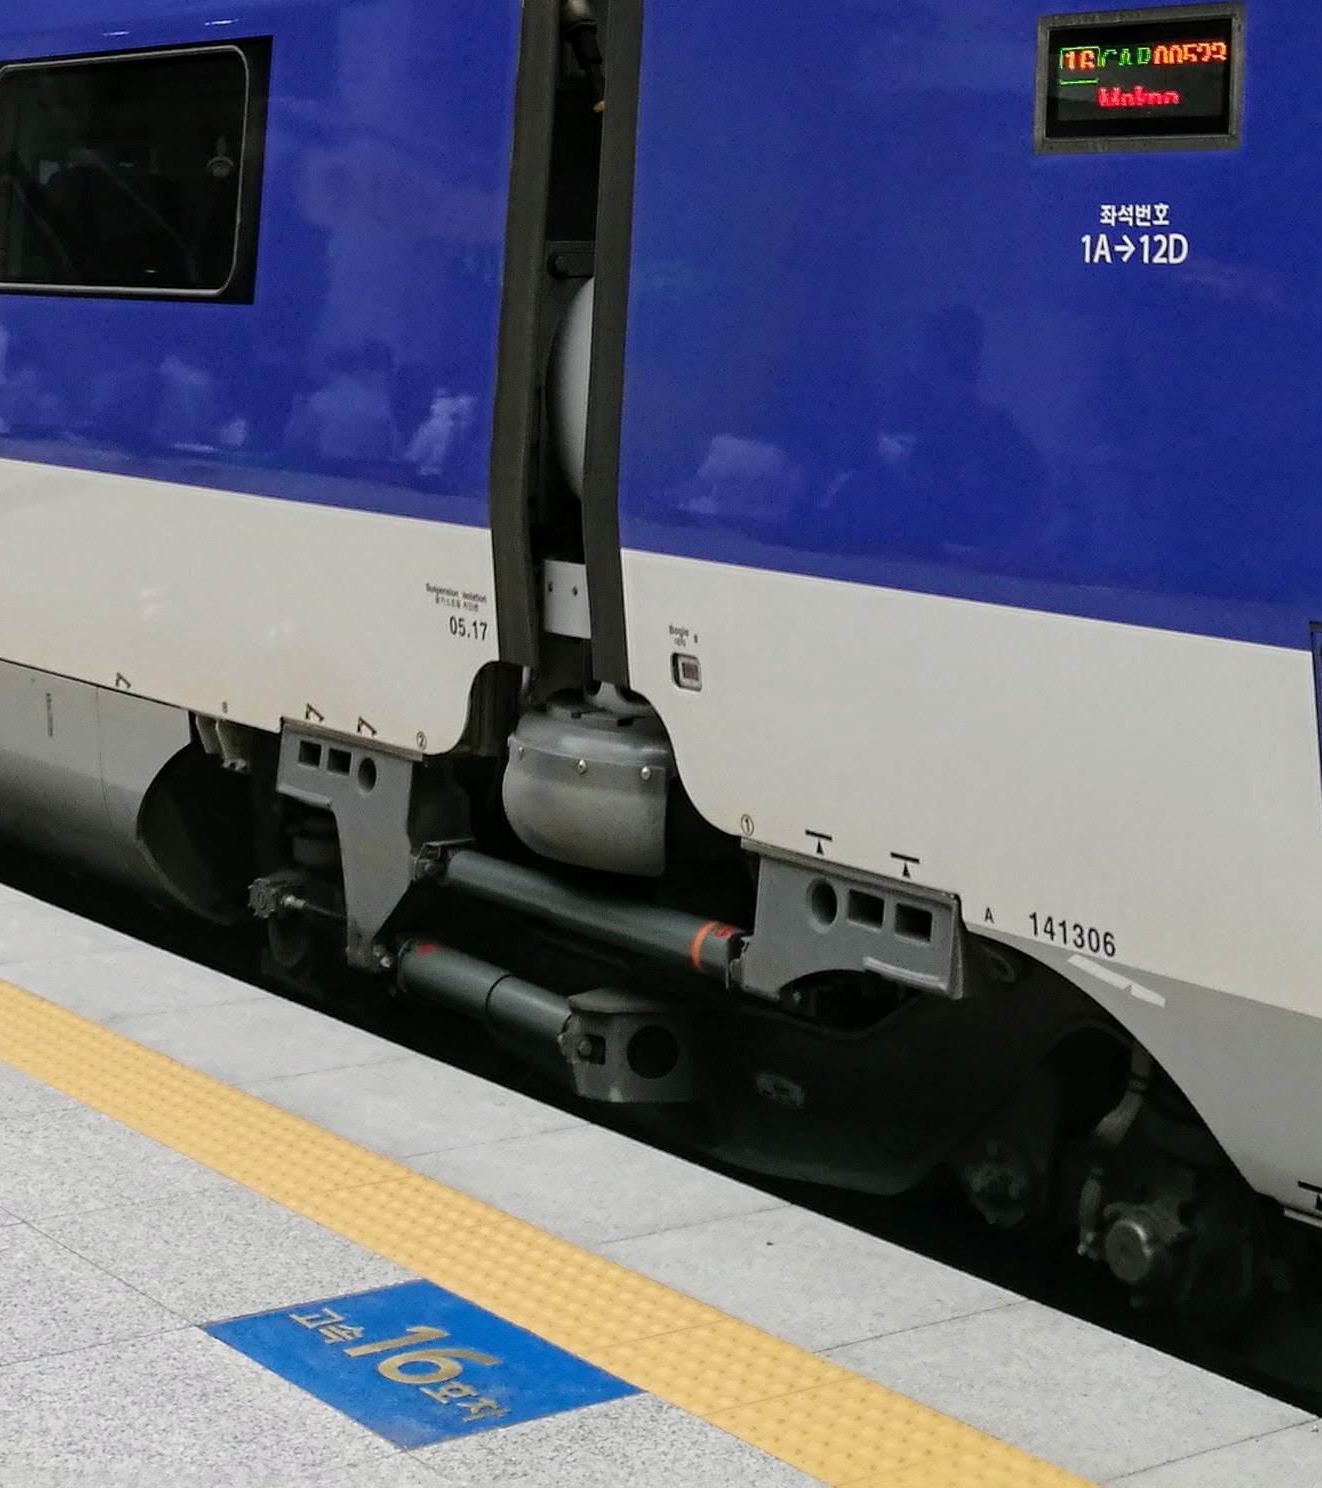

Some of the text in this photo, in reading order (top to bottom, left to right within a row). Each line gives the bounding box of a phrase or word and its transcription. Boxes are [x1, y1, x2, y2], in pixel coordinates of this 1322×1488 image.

[1099, 202, 1170, 227] 좌석번호
[448, 615, 488, 641] 05.17
[984, 907, 1116, 957] A 141306
